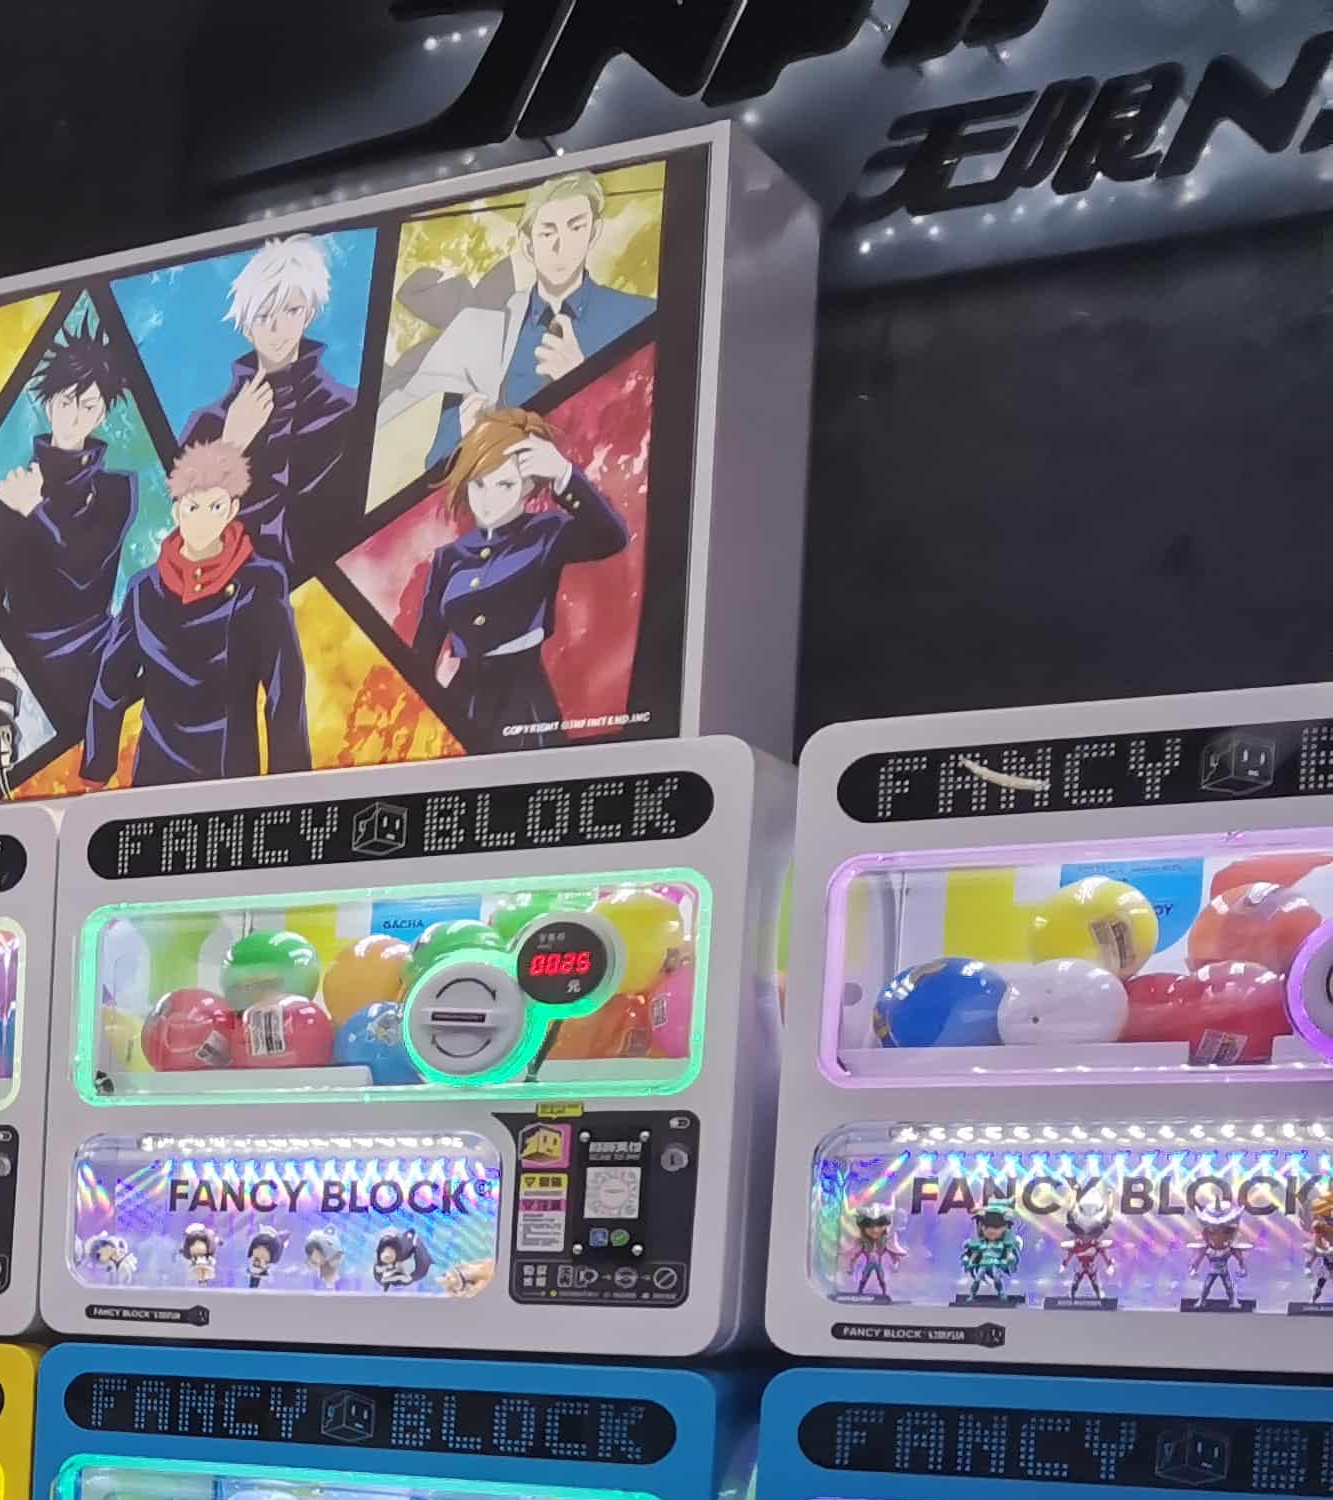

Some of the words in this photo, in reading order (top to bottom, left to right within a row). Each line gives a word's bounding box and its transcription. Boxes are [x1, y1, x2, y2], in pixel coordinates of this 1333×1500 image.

[877, 737, 1182, 817] FANCY
[117, 807, 338, 875] FANCY
[424, 777, 679, 852] BLOCK
[169, 1179, 309, 1214] FANCY
[321, 1179, 468, 1215] BLOCK
[843, 1327, 881, 1337] FANCY
[883, 1329, 922, 1339] BLOCK
[91, 1378, 308, 1440] FANCY
[391, 1391, 643, 1458] BLOCK
[834, 1409, 1136, 1481] FANCY
